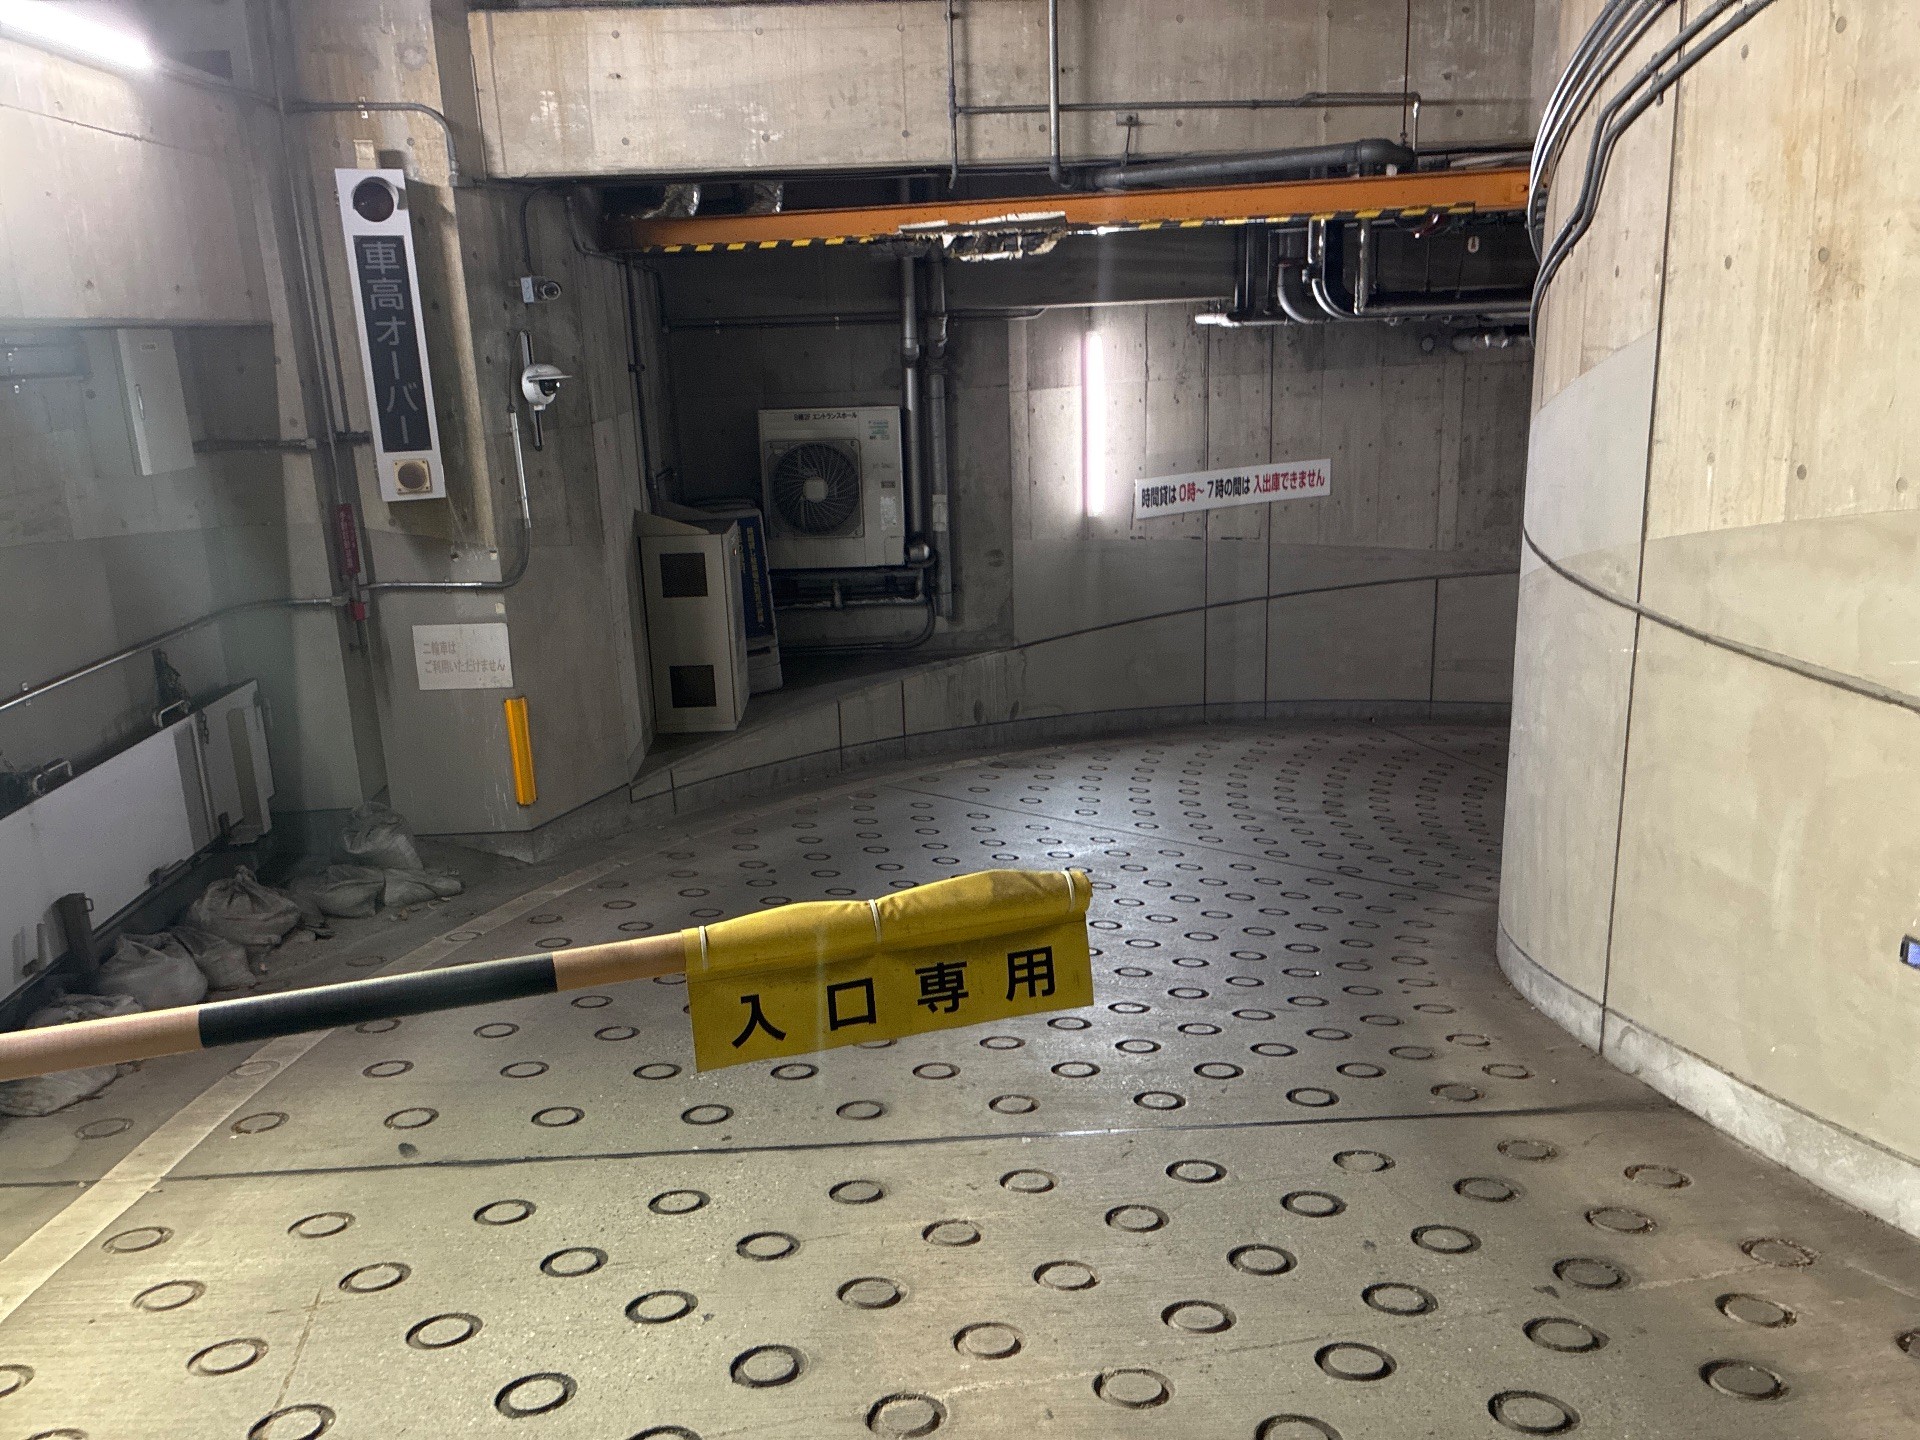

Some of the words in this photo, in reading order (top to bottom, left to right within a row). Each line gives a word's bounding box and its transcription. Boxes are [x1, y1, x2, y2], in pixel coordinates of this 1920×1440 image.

[362, 241, 418, 445] 車高オーバー
[732, 945, 1056, 1049] 入口専用
